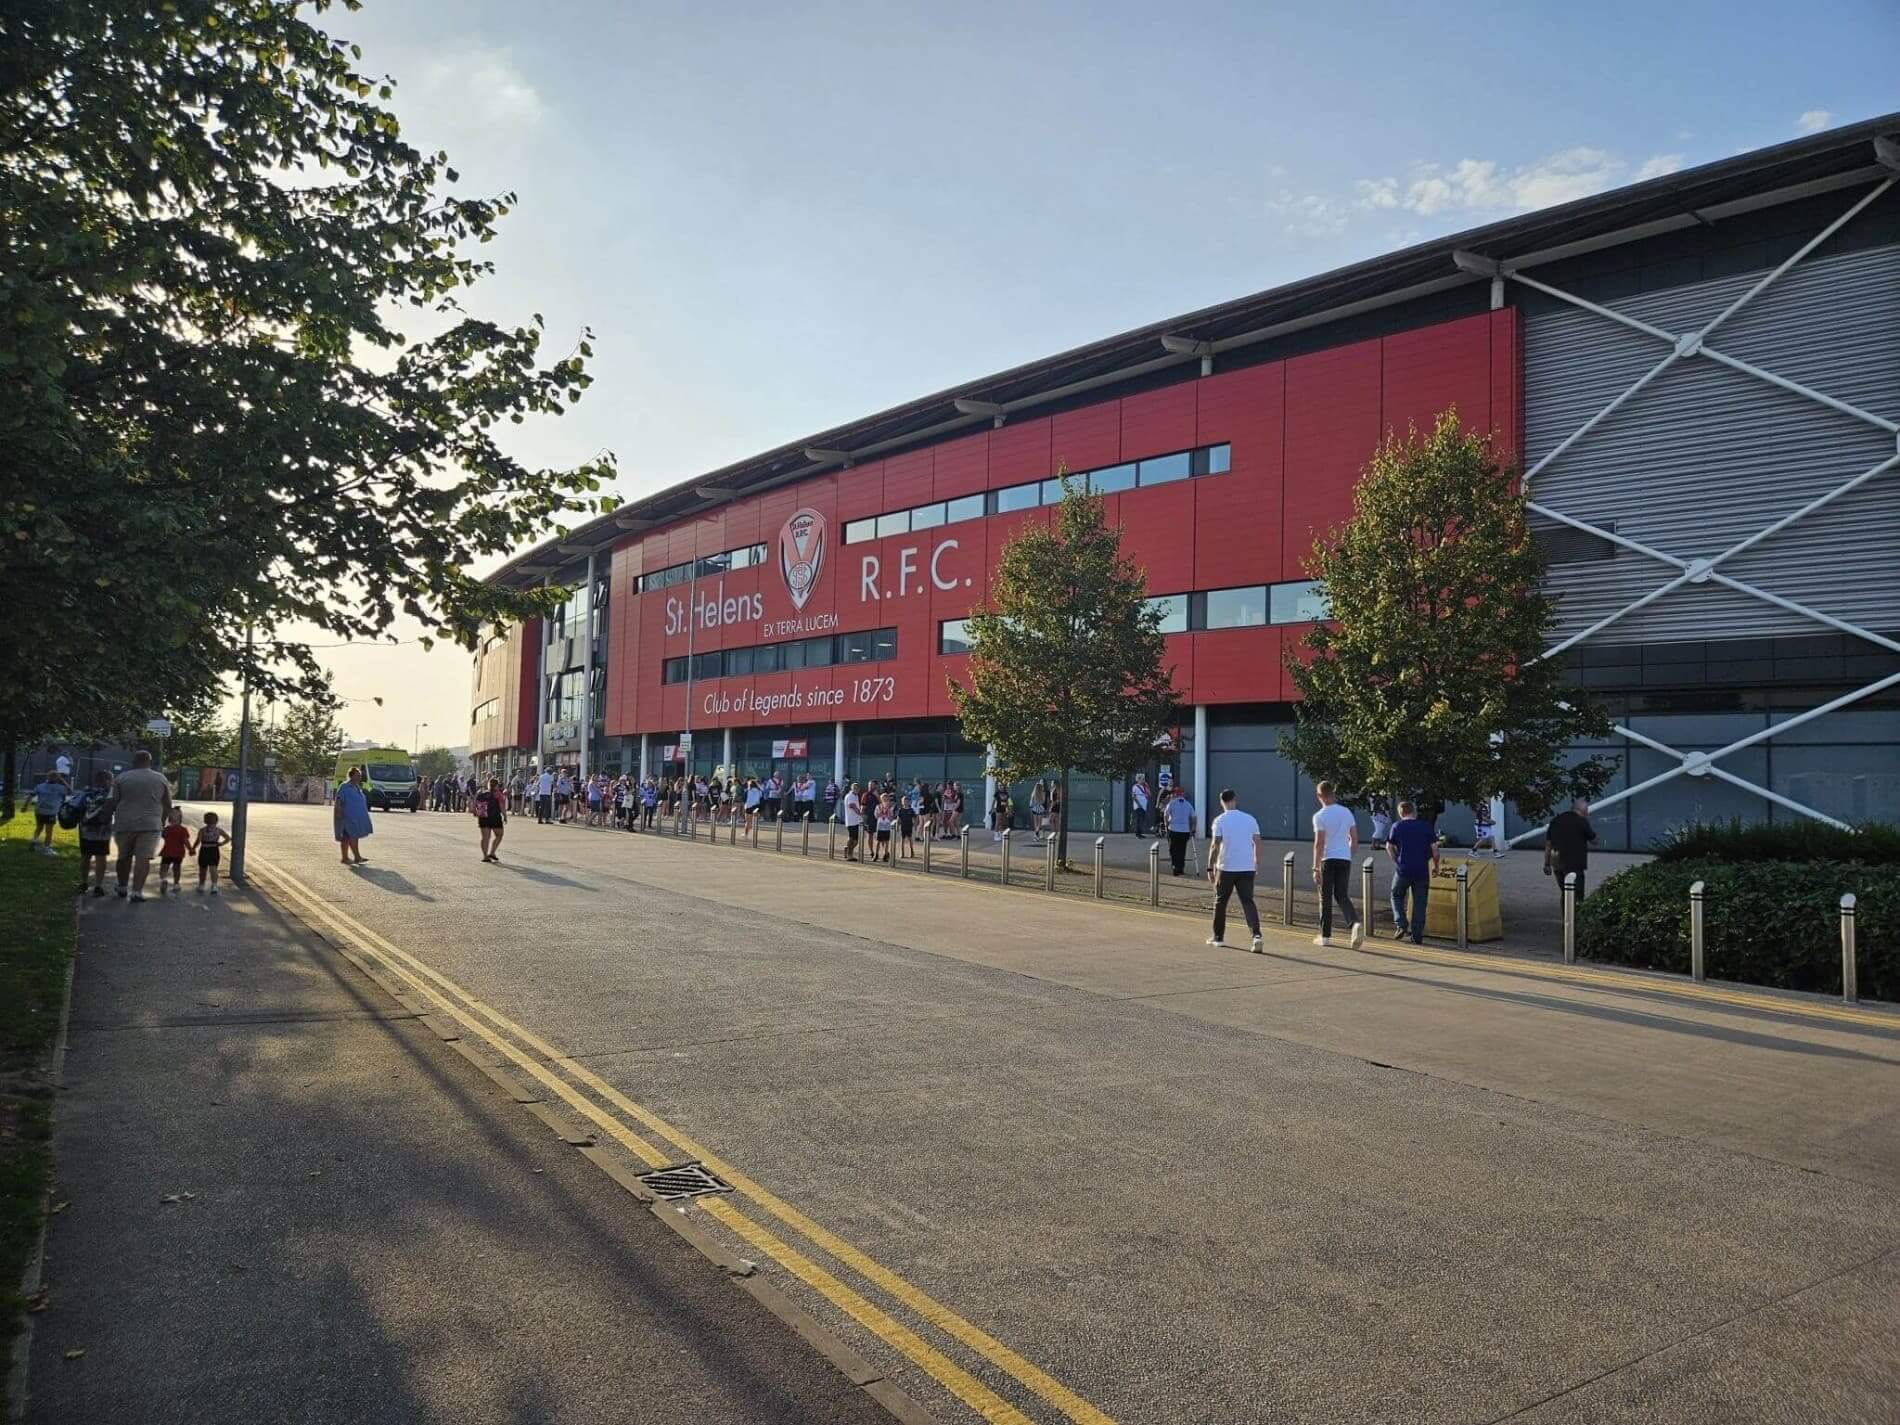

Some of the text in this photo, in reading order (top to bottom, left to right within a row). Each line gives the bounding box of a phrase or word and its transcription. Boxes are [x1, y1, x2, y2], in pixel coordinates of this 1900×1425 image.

[764, 613, 839, 638] EX TERRA LUCEM
[704, 676, 895, 714] Club of Legends since 1873
